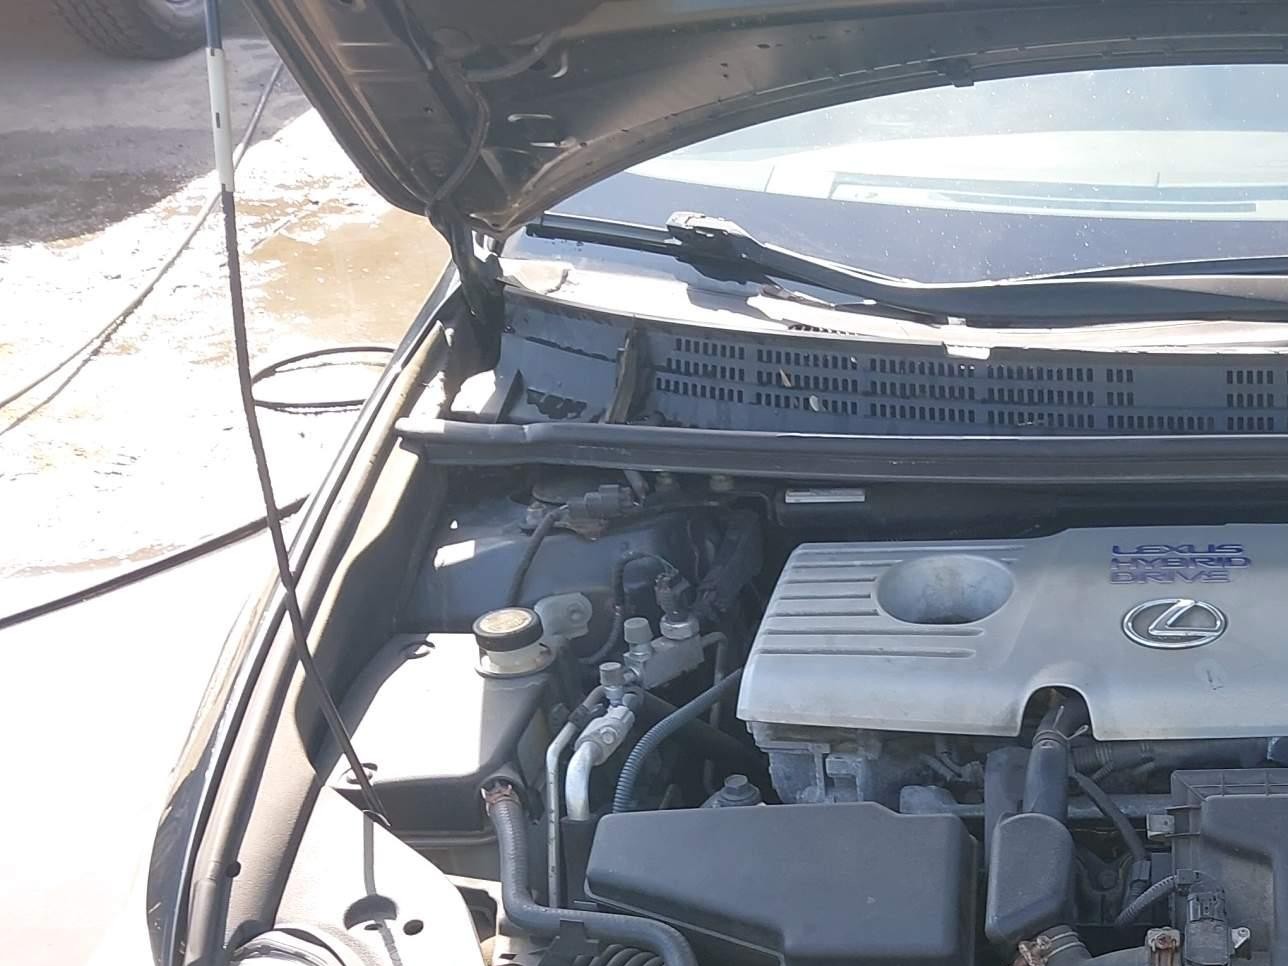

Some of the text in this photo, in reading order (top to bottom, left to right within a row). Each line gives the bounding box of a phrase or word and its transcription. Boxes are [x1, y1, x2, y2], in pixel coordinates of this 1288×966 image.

[1112, 544, 1244, 555] LEXUS
[1111, 557, 1252, 569] HYBRID
[1110, 570, 1231, 583] DRIVE
